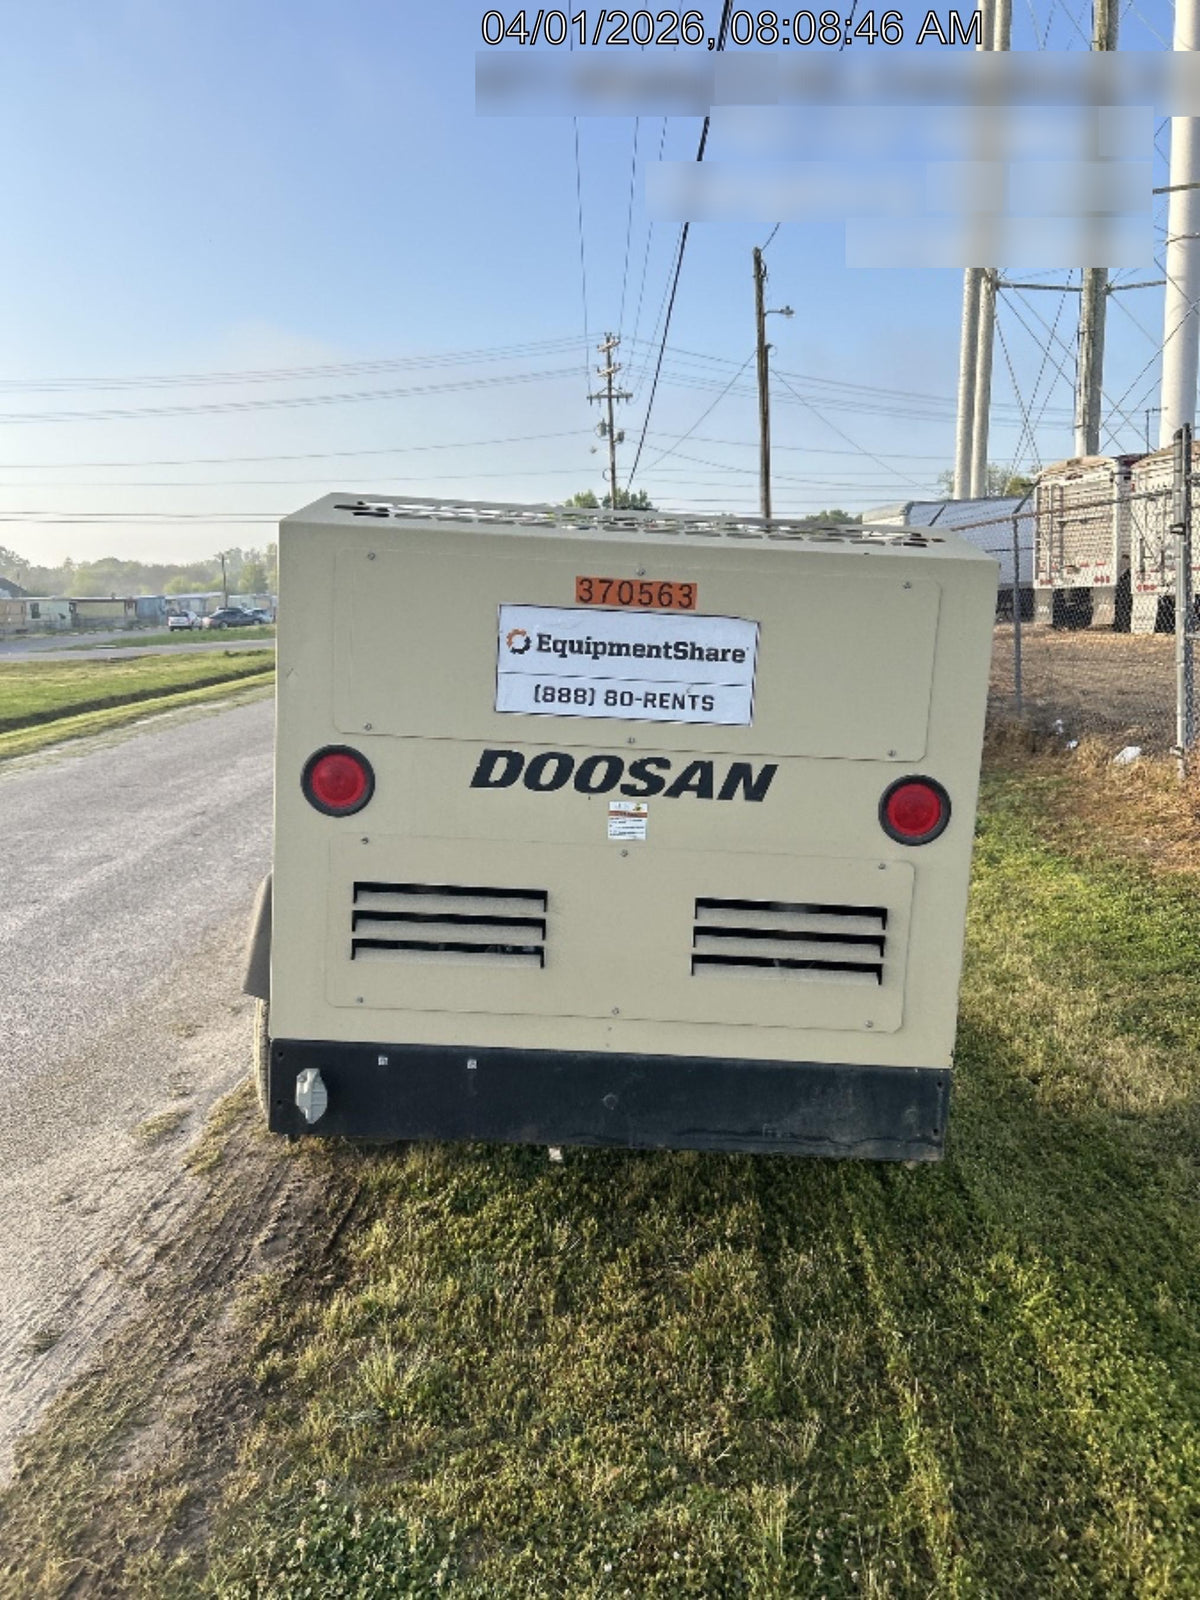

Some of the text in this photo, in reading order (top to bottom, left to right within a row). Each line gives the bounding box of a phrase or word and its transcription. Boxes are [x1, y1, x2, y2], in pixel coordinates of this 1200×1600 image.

[578, 578, 694, 609] 370563
[537, 633, 746, 663] EquipmentShare
[533, 684, 715, 712] (888) 80-RENTS
[469, 749, 779, 802] DOOSAN
